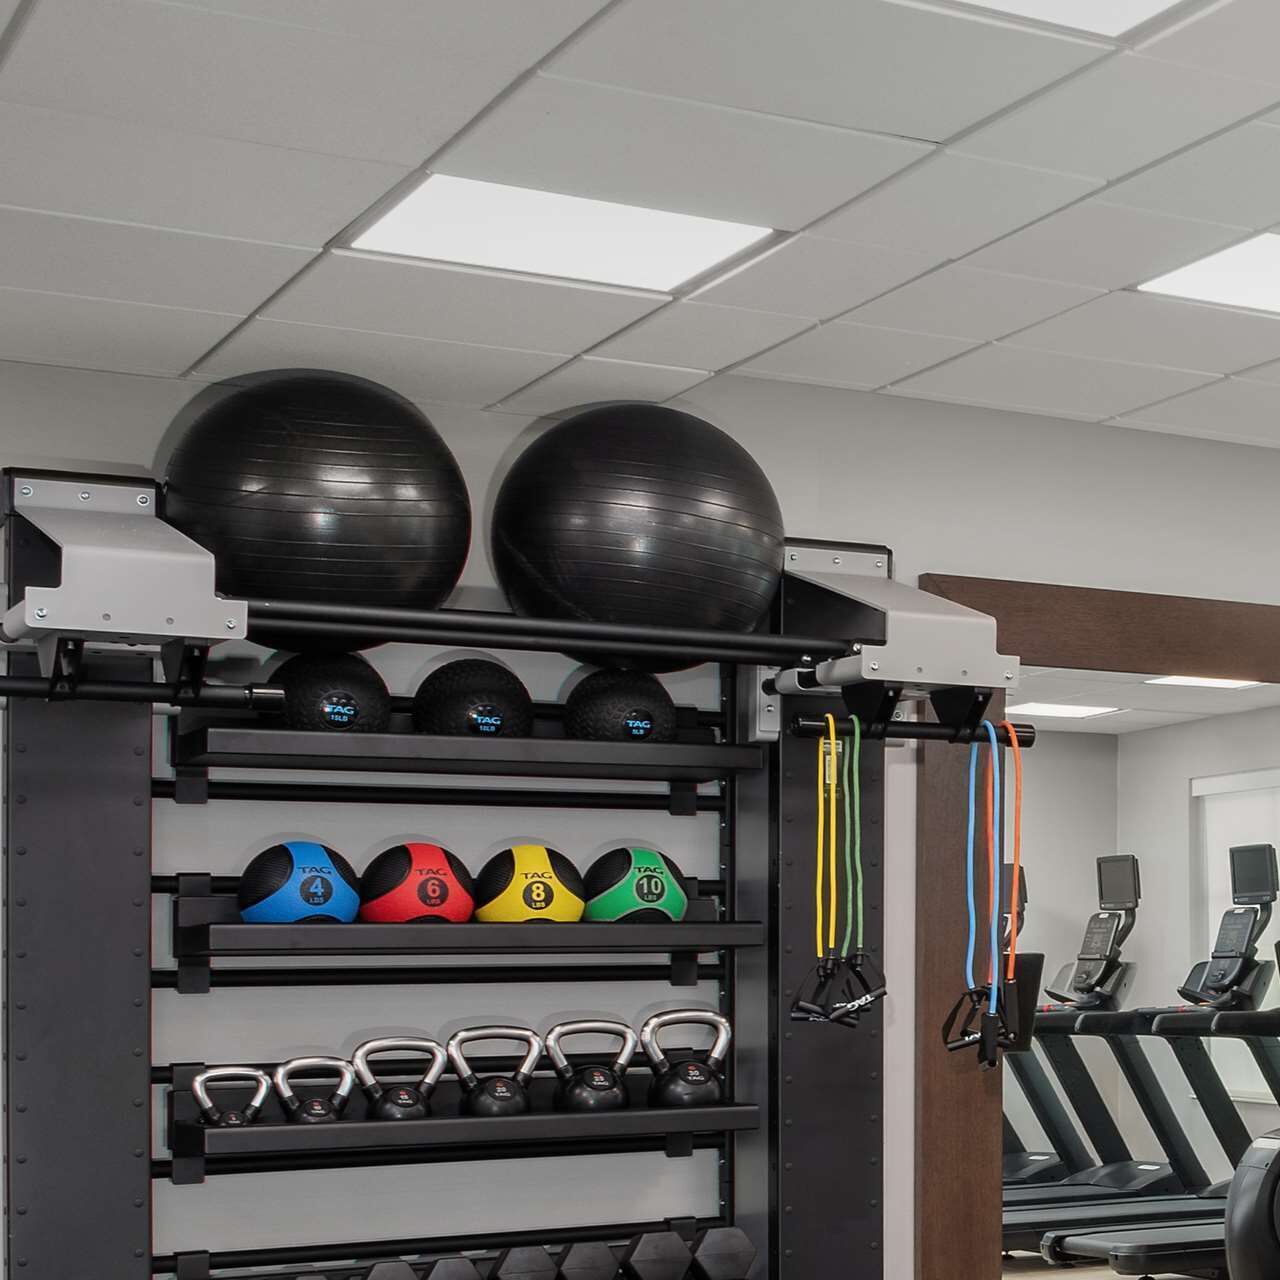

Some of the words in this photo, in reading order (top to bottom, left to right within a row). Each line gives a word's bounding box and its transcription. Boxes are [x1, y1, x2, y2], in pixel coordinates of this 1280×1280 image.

[328, 704, 355, 715] TAG
[475, 716, 501, 725] TAG
[626, 719, 651, 729] TAG
[297, 866, 332, 875] TAG
[416, 868, 448, 877] TAG
[520, 871, 553, 880] TAG
[633, 866, 664, 875] TAG
[309, 877, 324, 897] 4
[426, 878, 441, 898] 6
[638, 876, 662, 895] 10
[531, 882, 546, 902] 8
